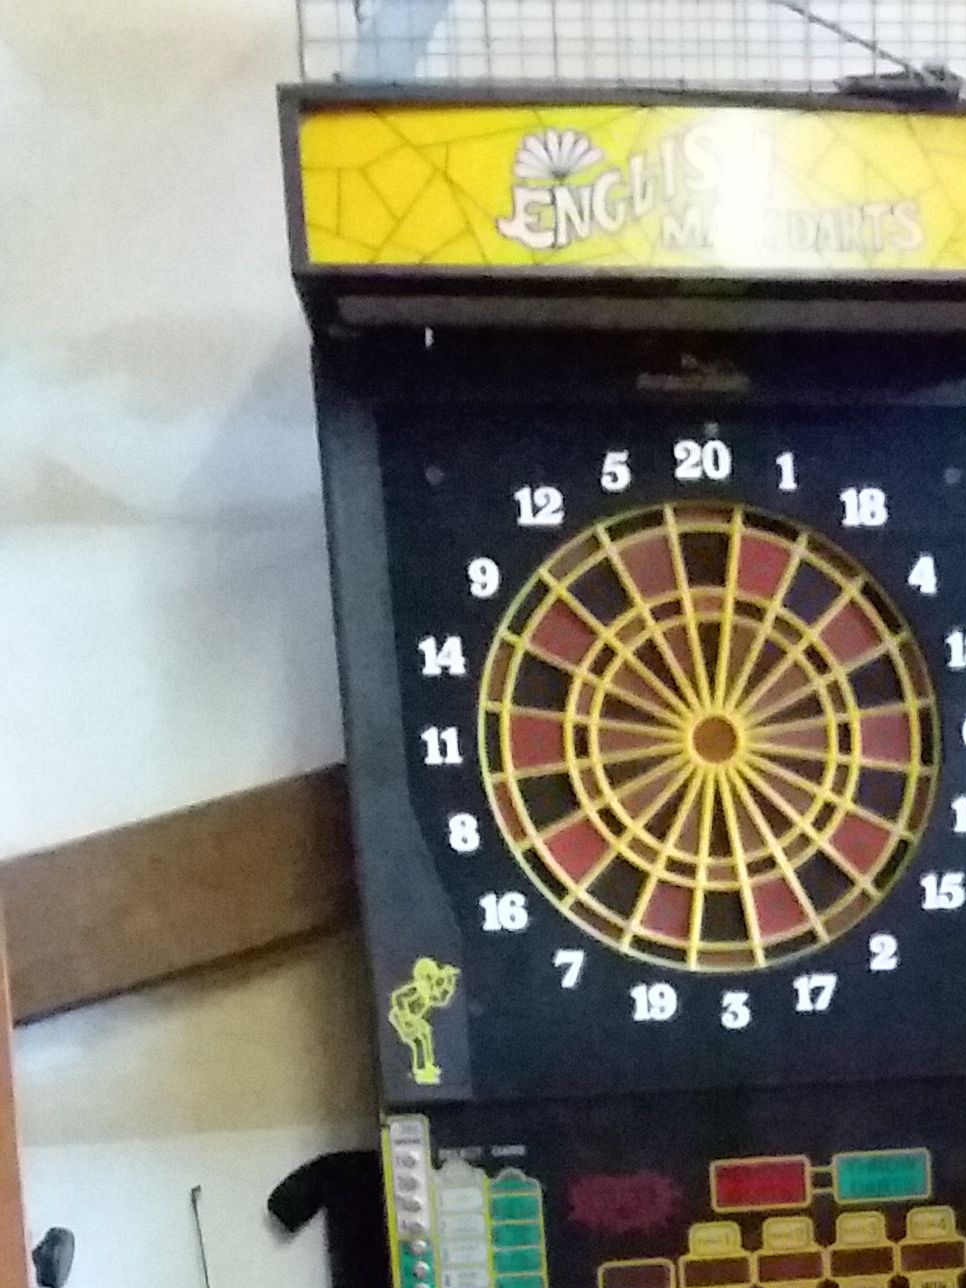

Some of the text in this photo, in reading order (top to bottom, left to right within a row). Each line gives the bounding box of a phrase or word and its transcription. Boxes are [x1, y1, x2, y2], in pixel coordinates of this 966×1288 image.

[600, 451, 631, 491] 5
[673, 440, 732, 480] 20
[775, 452, 798, 491] 1
[514, 486, 565, 526] 12
[839, 487, 889, 527] 18
[467, 557, 500, 598] 9
[907, 554, 937, 594] 4
[418, 636, 467, 676] 14
[420, 726, 464, 765] 11
[448, 813, 481, 853] 8
[920, 871, 966, 910] 15
[479, 891, 529, 932] 16
[553, 949, 585, 988] 7
[869, 933, 898, 971] 2
[630, 982, 678, 1022] 19
[793, 973, 838, 1012] 17
